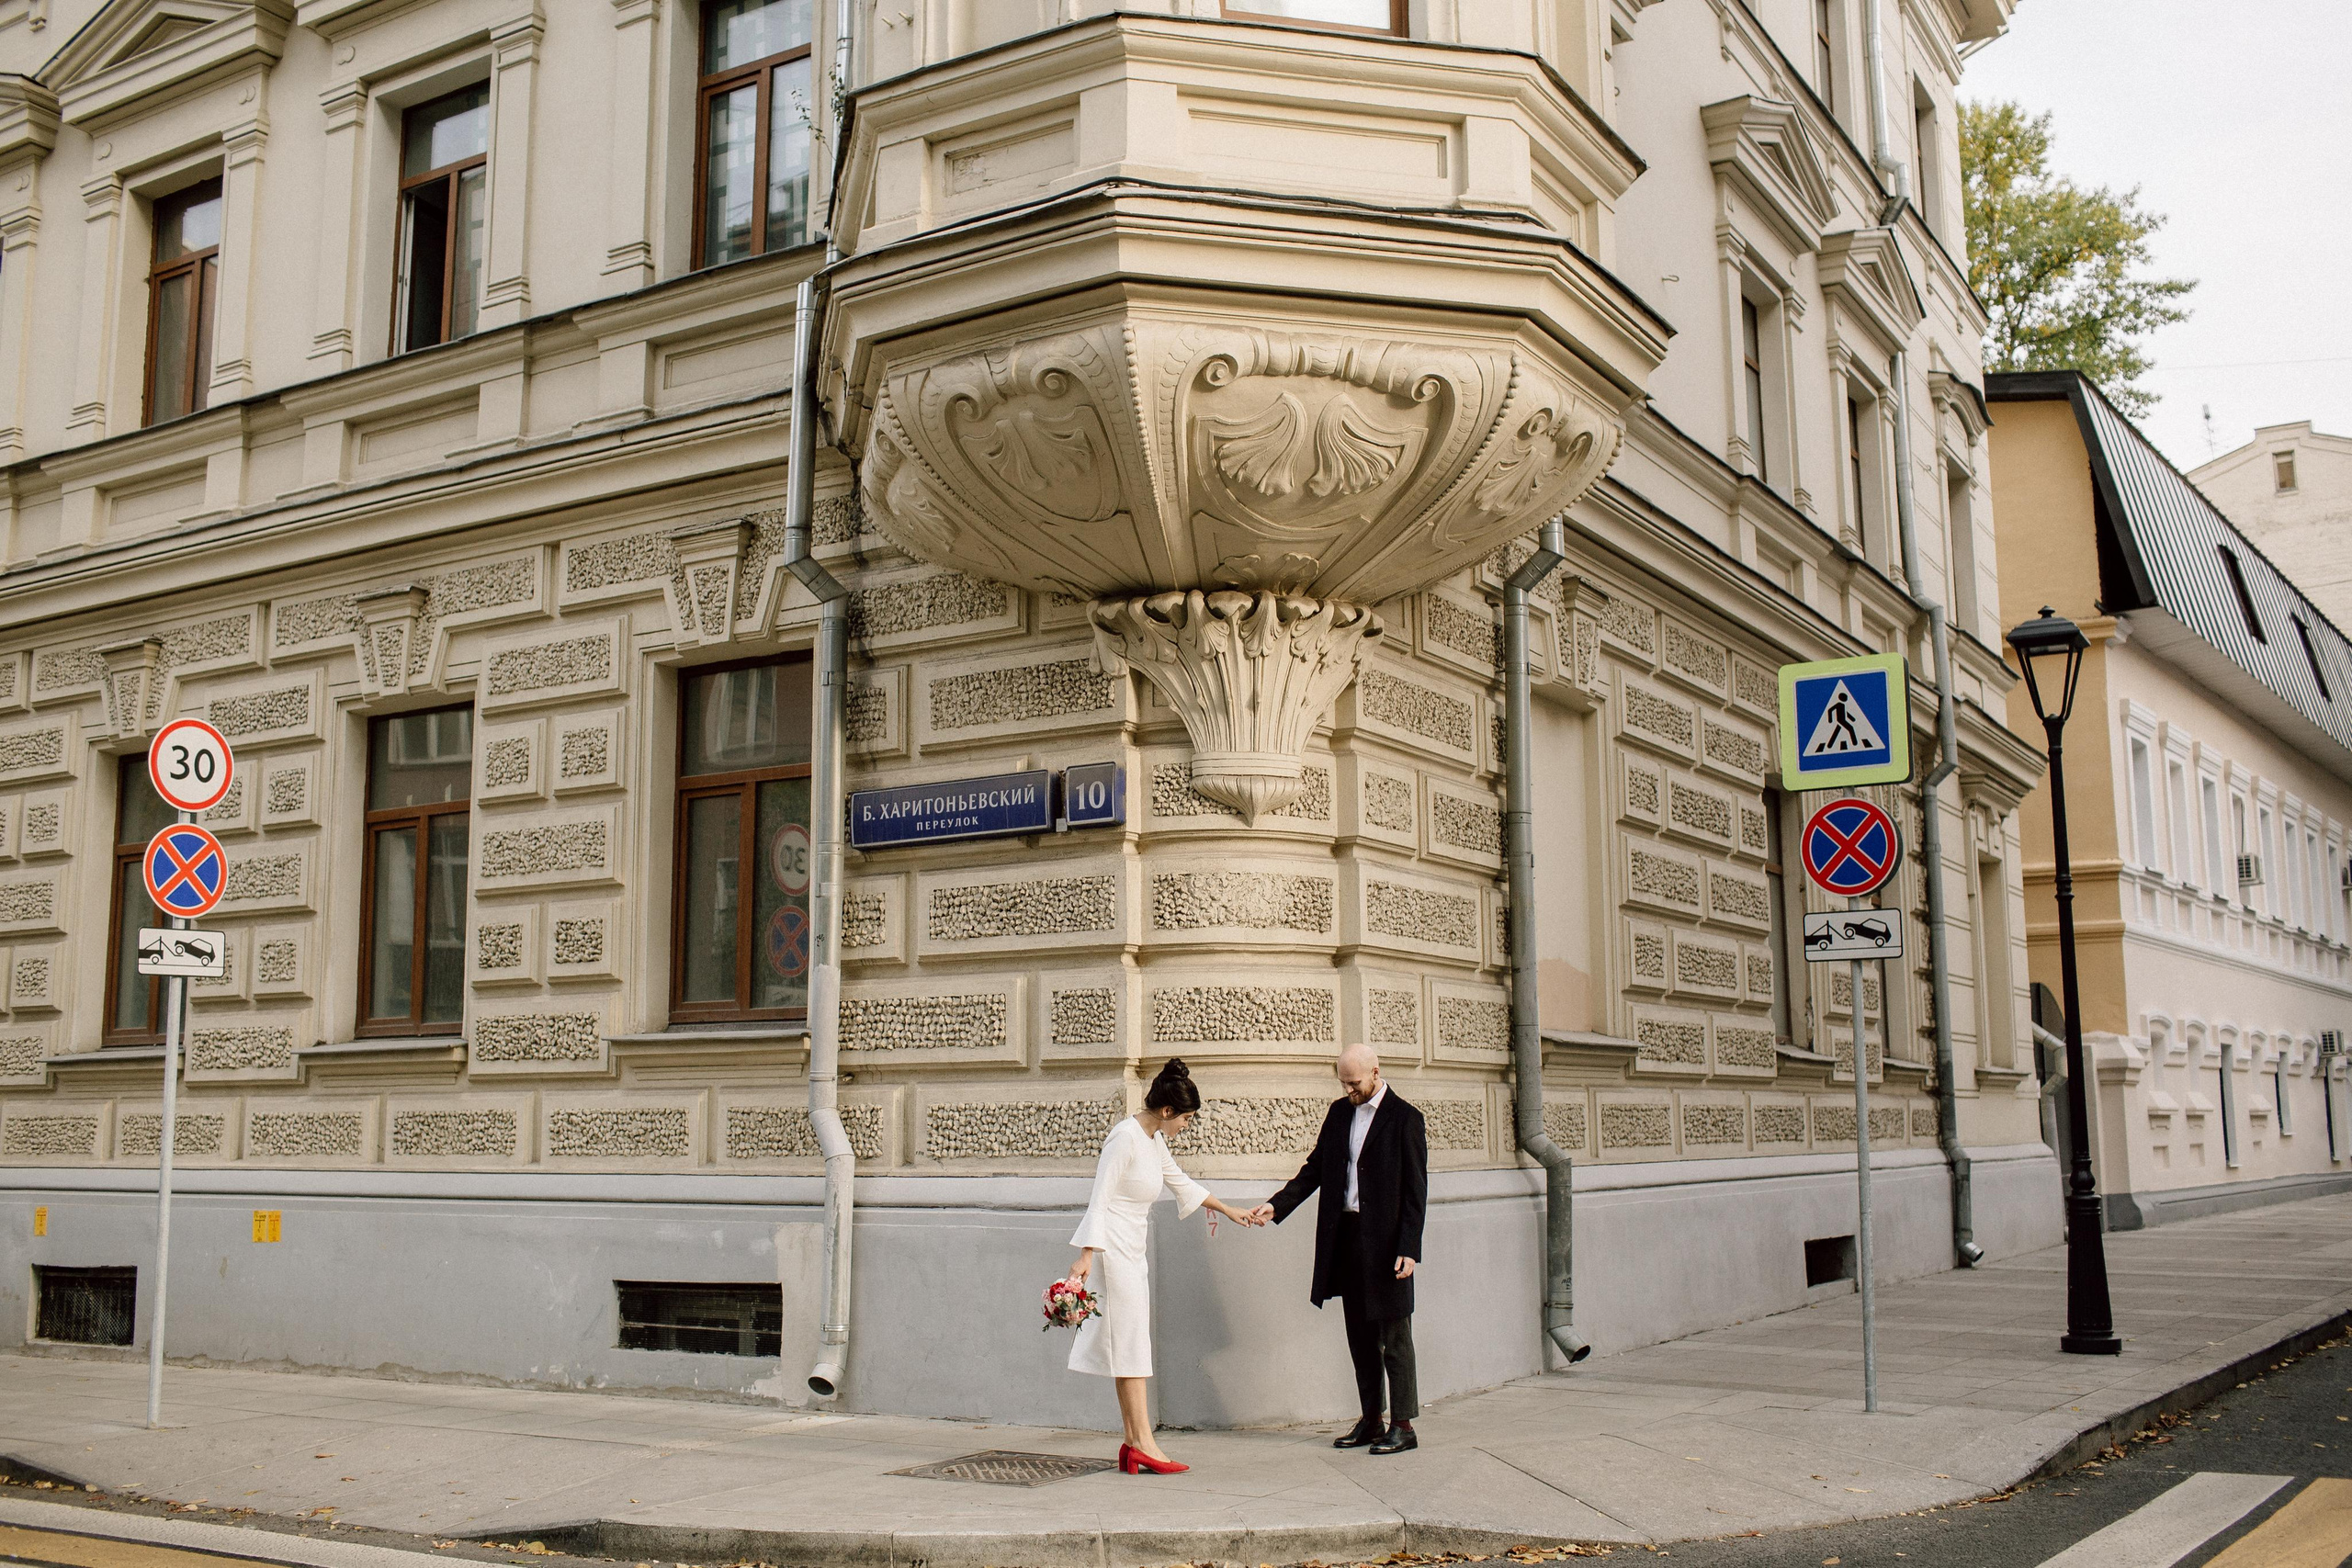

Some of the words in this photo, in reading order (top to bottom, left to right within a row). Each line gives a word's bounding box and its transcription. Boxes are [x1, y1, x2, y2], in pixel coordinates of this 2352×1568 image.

[170, 745, 216, 783] 30
[863, 805, 876, 822] Б.
[880, 784, 1035, 820] ХАРИТОНЬЕВСКИЙ
[1076, 781, 1106, 811] 10
[916, 816, 979, 832] ПЕРЕУЛОК
